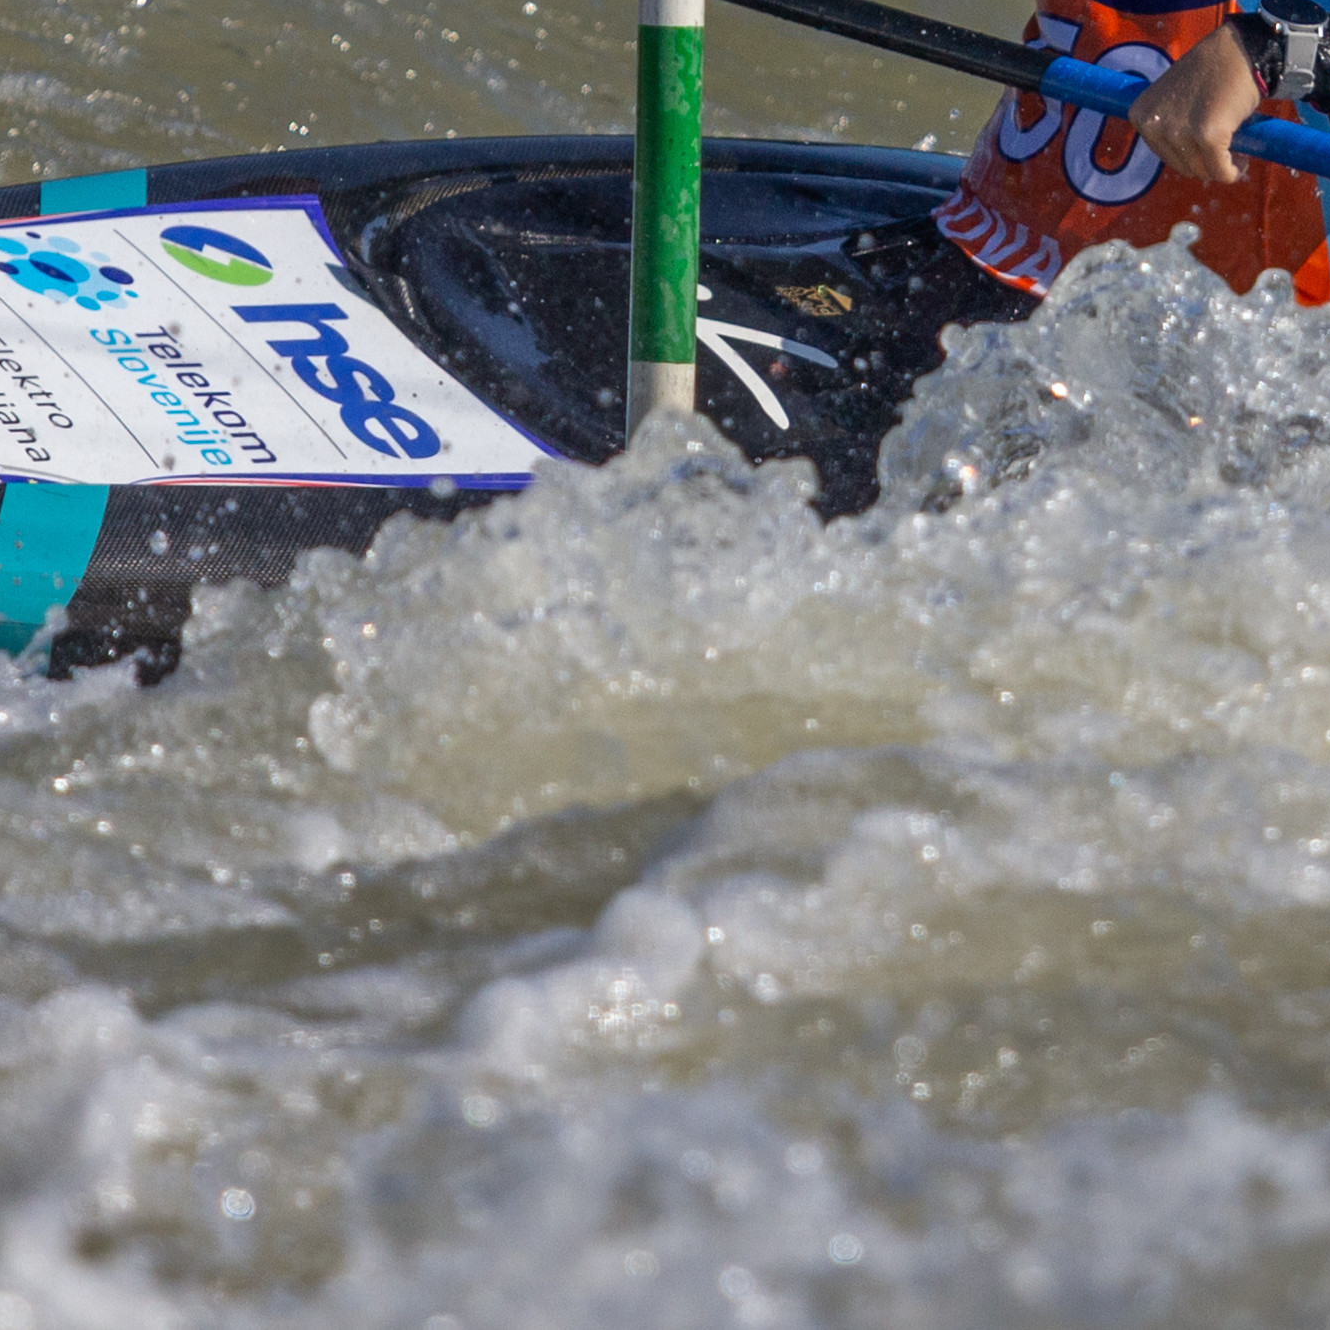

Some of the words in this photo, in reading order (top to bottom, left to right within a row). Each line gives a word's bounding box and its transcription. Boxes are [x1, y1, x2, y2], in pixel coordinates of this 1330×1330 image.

[90, 329, 232, 466] Slovenije
[136, 326, 277, 464] Telekom
[230, 303, 441, 459] hse
